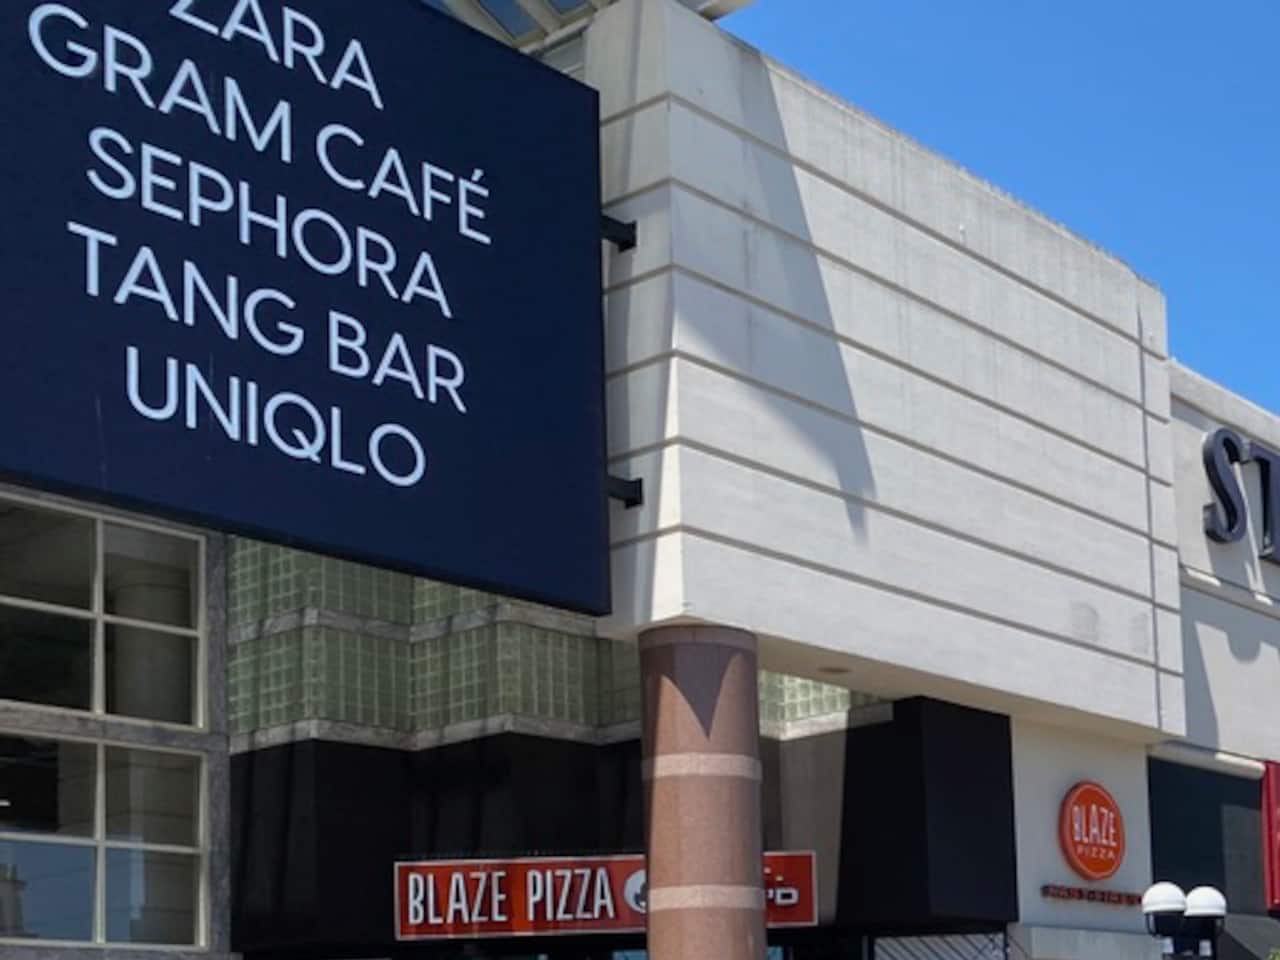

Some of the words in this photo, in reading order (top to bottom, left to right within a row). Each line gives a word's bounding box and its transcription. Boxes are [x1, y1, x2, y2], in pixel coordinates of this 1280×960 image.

[28, 3, 292, 164] GRAM
[315, 124, 492, 246] CAFÉ
[86, 127, 453, 320] SEPHORA
[67, 221, 304, 357] TANG
[328, 310, 467, 414] BAR
[125, 346, 427, 488] UNIQLO
[407, 870, 508, 926] BLAZE
[526, 867, 616, 921] PIZZA
[1071, 803, 1118, 847] BLAZE
